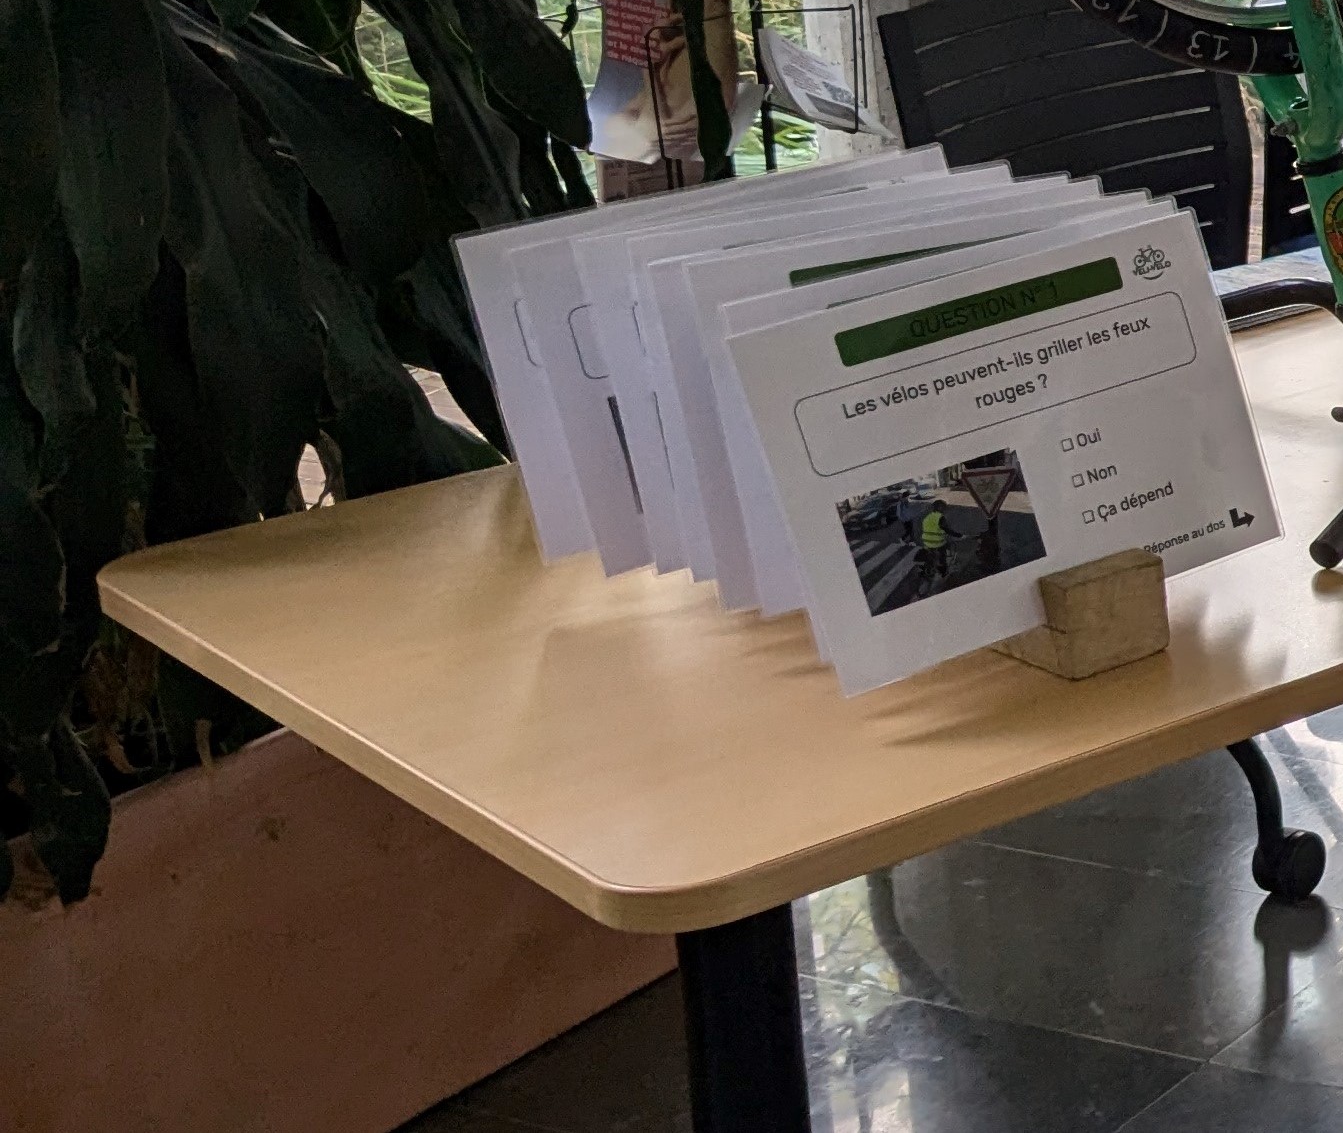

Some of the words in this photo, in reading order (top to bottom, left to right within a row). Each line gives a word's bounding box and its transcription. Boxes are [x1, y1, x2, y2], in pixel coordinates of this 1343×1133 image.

[1186, 30, 1233, 61] 13
[910, 294, 1016, 338] QUESTION
[1021, 287, 1042, 308] N°
[842, 397, 878, 419] Les
[880, 380, 929, 408] vélos
[932, 351, 1034, 395] peuvent-ils
[1037, 336, 1083, 365] griller
[1087, 327, 1111, 347] les
[1113, 316, 1151, 341] feux
[975, 378, 1037, 409] rouges
[1037, 373, 1048, 388] ?
[1076, 427, 1102, 448] Oui
[1086, 464, 1118, 484] Non
[1096, 504, 1118, 522] Ça
[1120, 481, 1174, 511] dépend
[1191, 527, 1205, 540] au
[1206, 519, 1226, 534] dos
